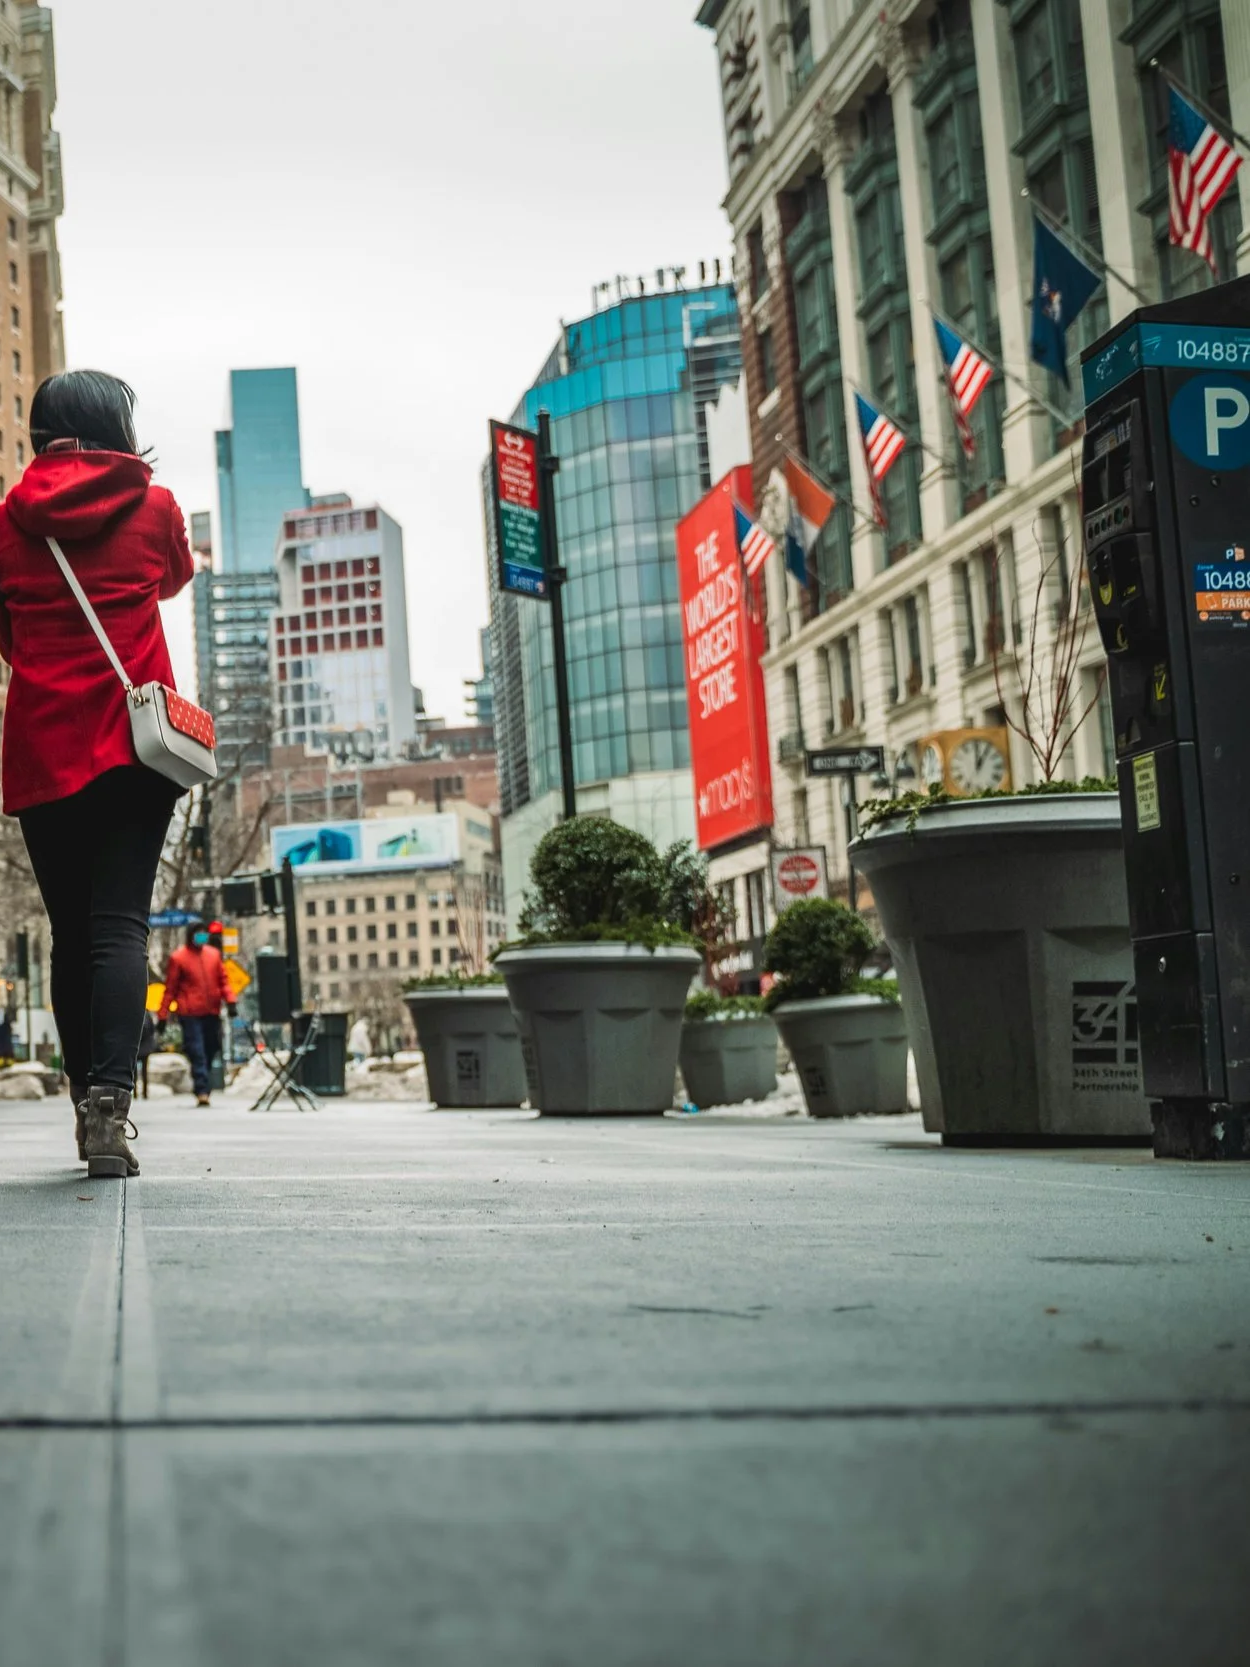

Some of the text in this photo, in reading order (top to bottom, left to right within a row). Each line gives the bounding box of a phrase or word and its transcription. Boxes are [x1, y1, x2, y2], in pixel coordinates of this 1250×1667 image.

[1204, 386, 1250, 457] P
[694, 529, 720, 582] THE
[688, 609, 738, 680] LARGEST
[698, 660, 737, 719] STORE
[1072, 1082, 1139, 1092] Partnership
[1102, 1068, 1138, 1078] Street
